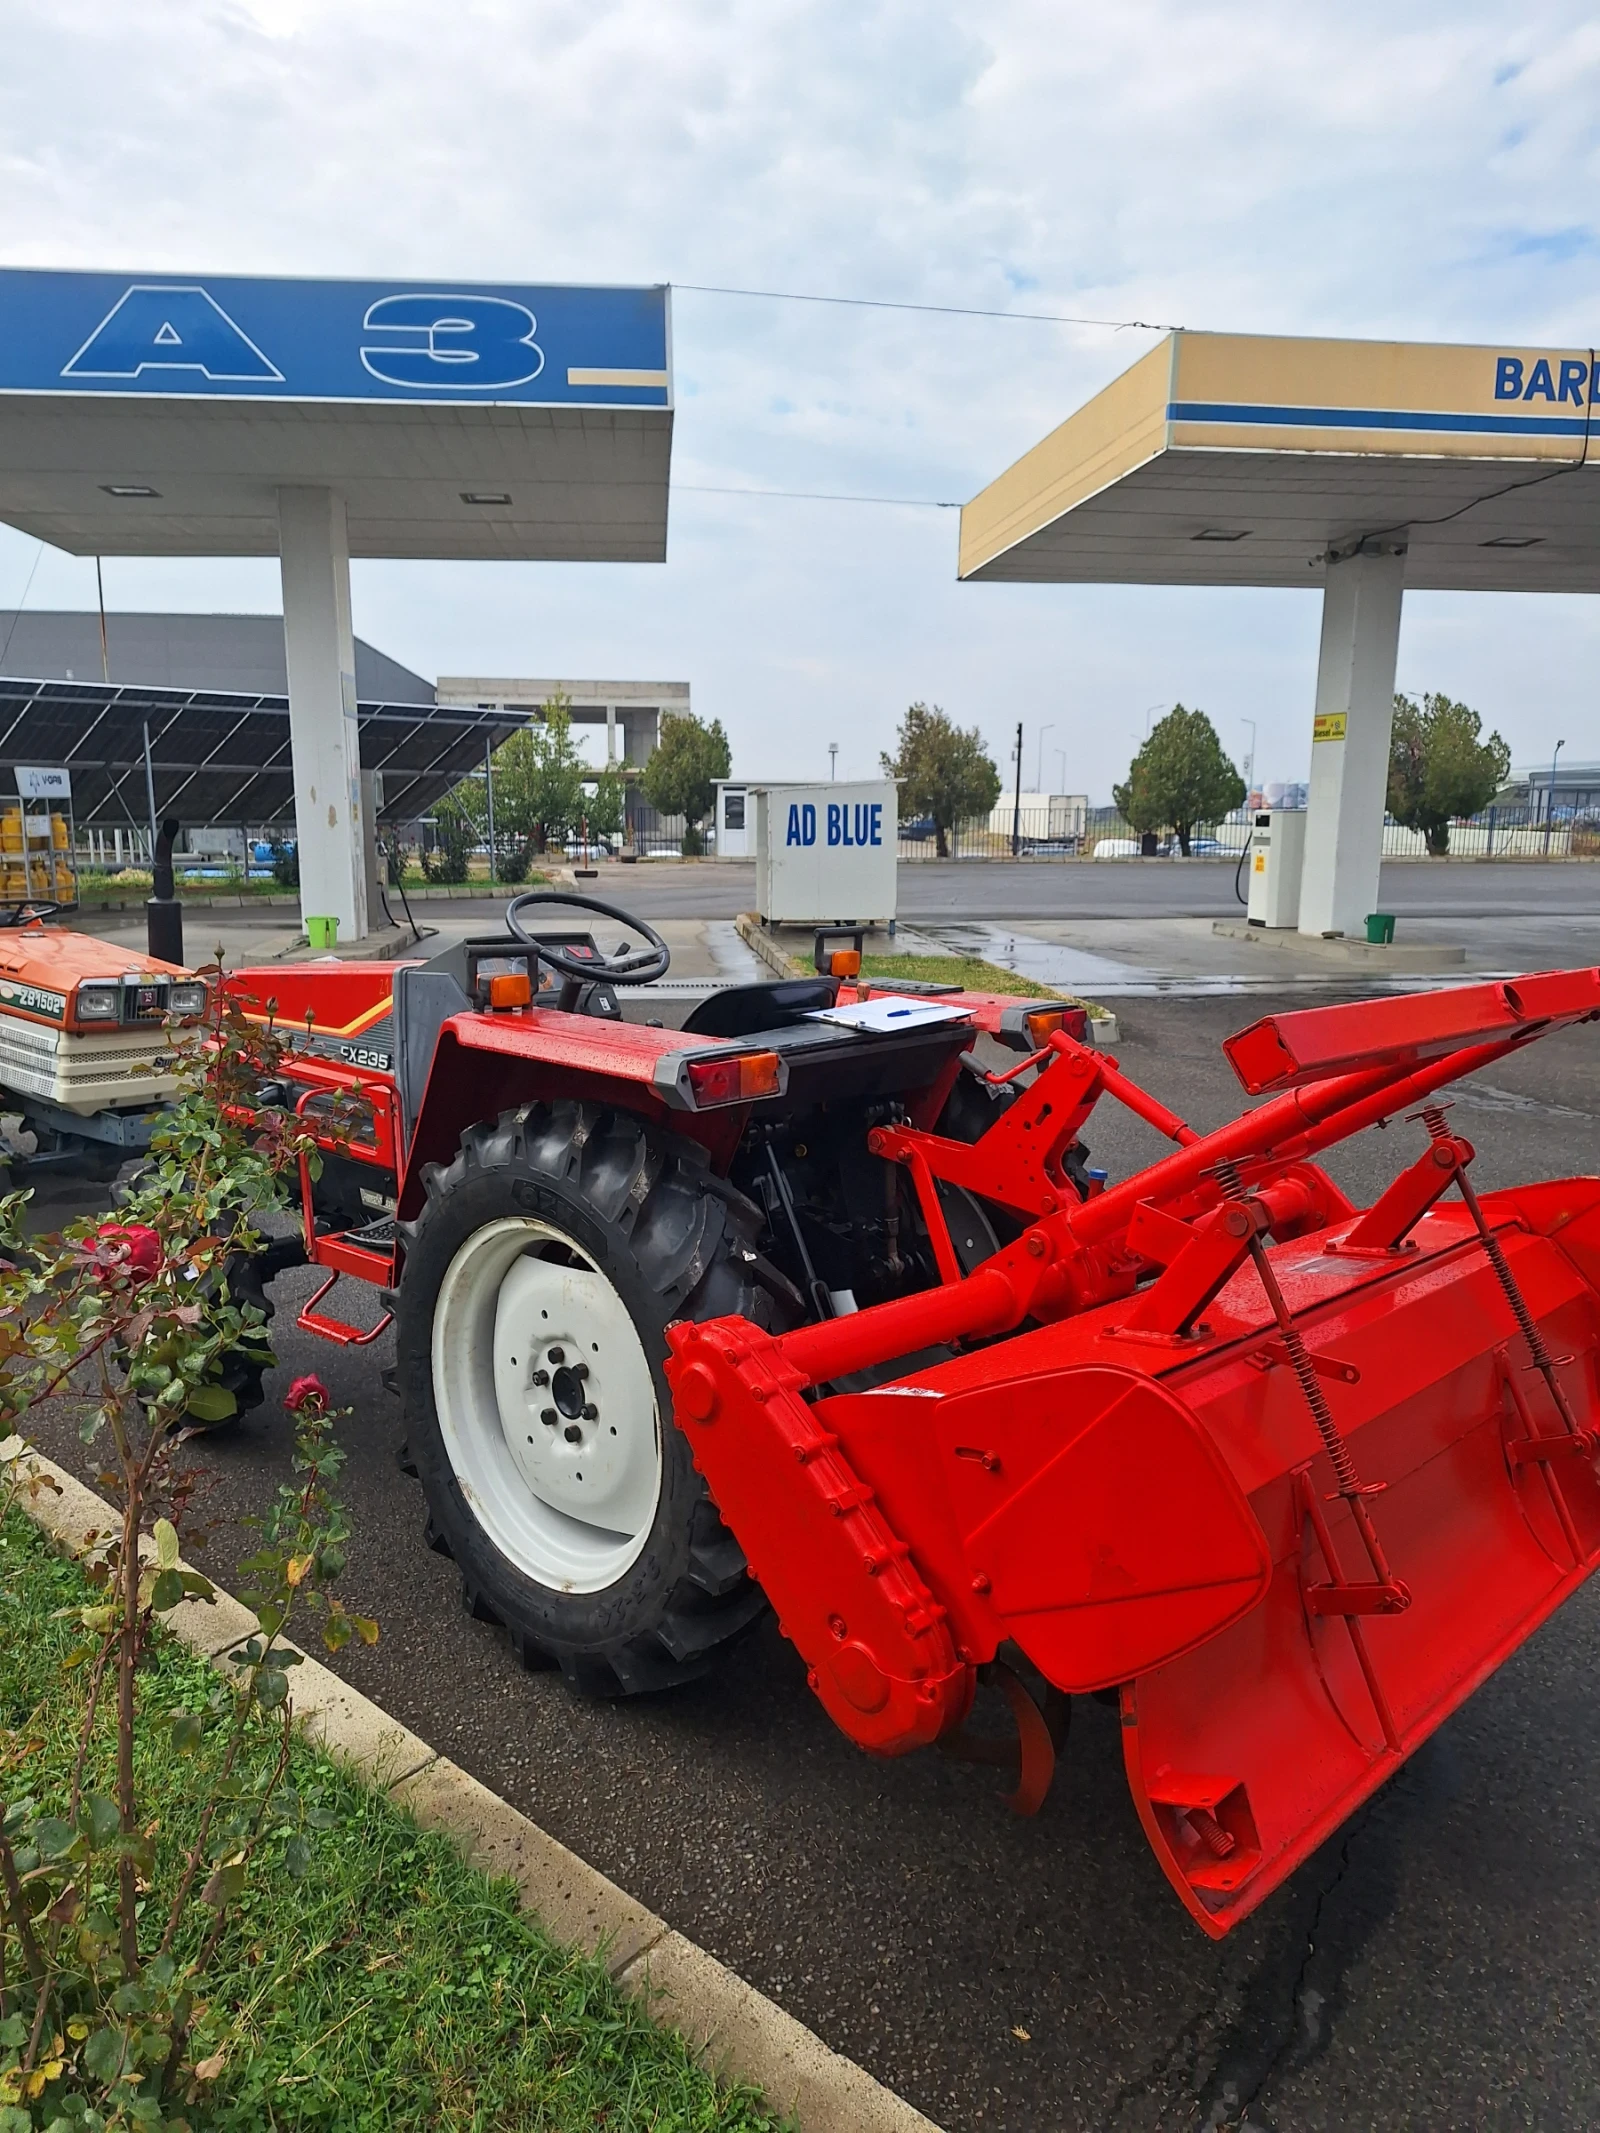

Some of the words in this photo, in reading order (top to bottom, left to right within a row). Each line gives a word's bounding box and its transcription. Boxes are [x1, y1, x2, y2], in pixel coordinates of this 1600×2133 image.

[60, 285, 286, 383] A
[359, 293, 546, 390] 3
[786, 804, 816, 846] AD
[827, 804, 883, 846] BLUE
